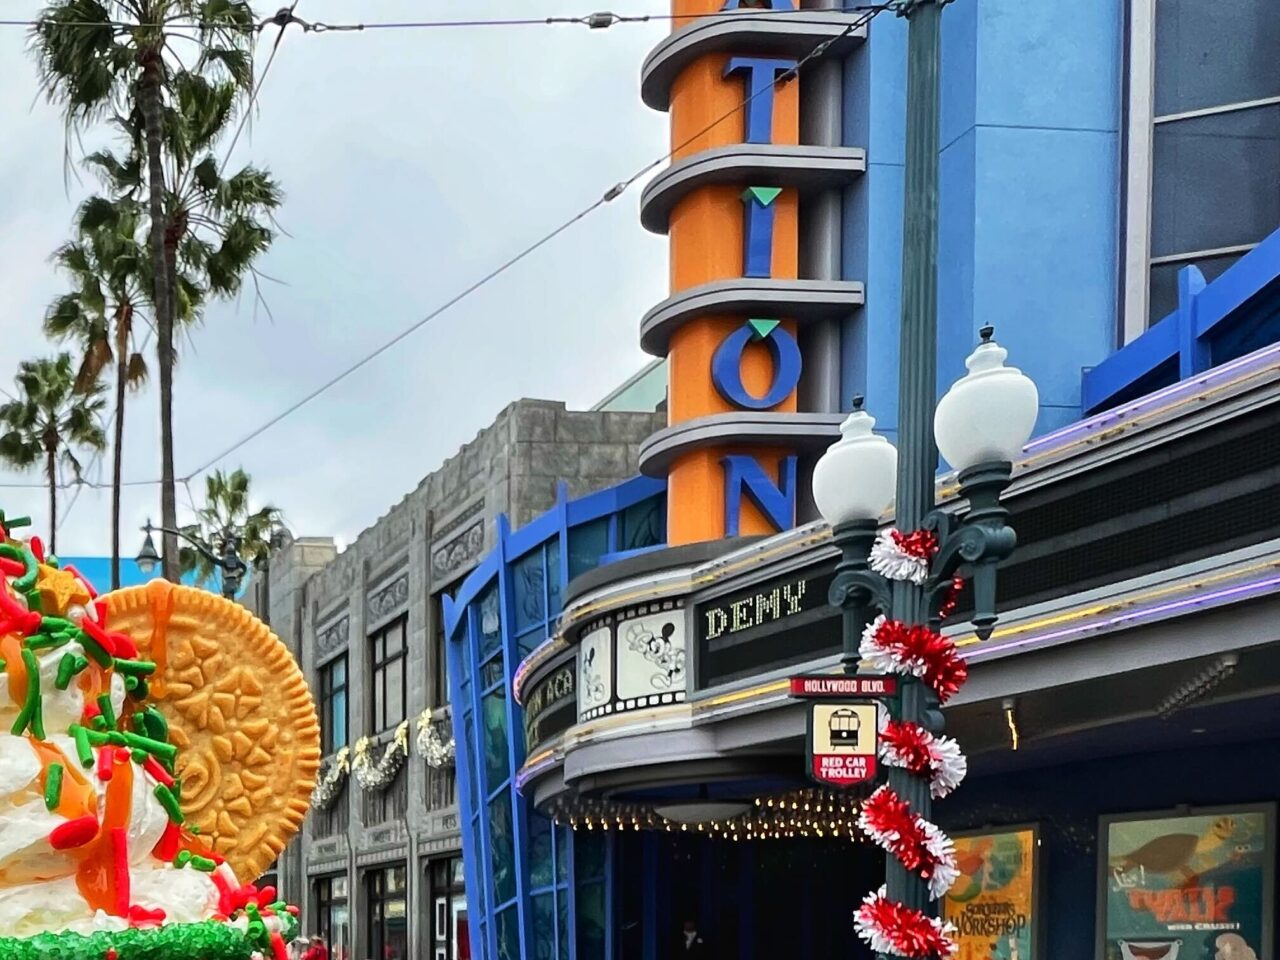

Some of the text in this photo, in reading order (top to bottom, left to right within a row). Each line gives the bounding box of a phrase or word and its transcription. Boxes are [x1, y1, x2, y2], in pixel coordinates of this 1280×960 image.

[711, 0, 803, 538] TION
[706, 580, 805, 639] DEMY
[804, 679, 885, 692] HOLLYWOOD BLVD.
[822, 757, 866, 767] RED CAR
[820, 768, 867, 778] TROLLEY
